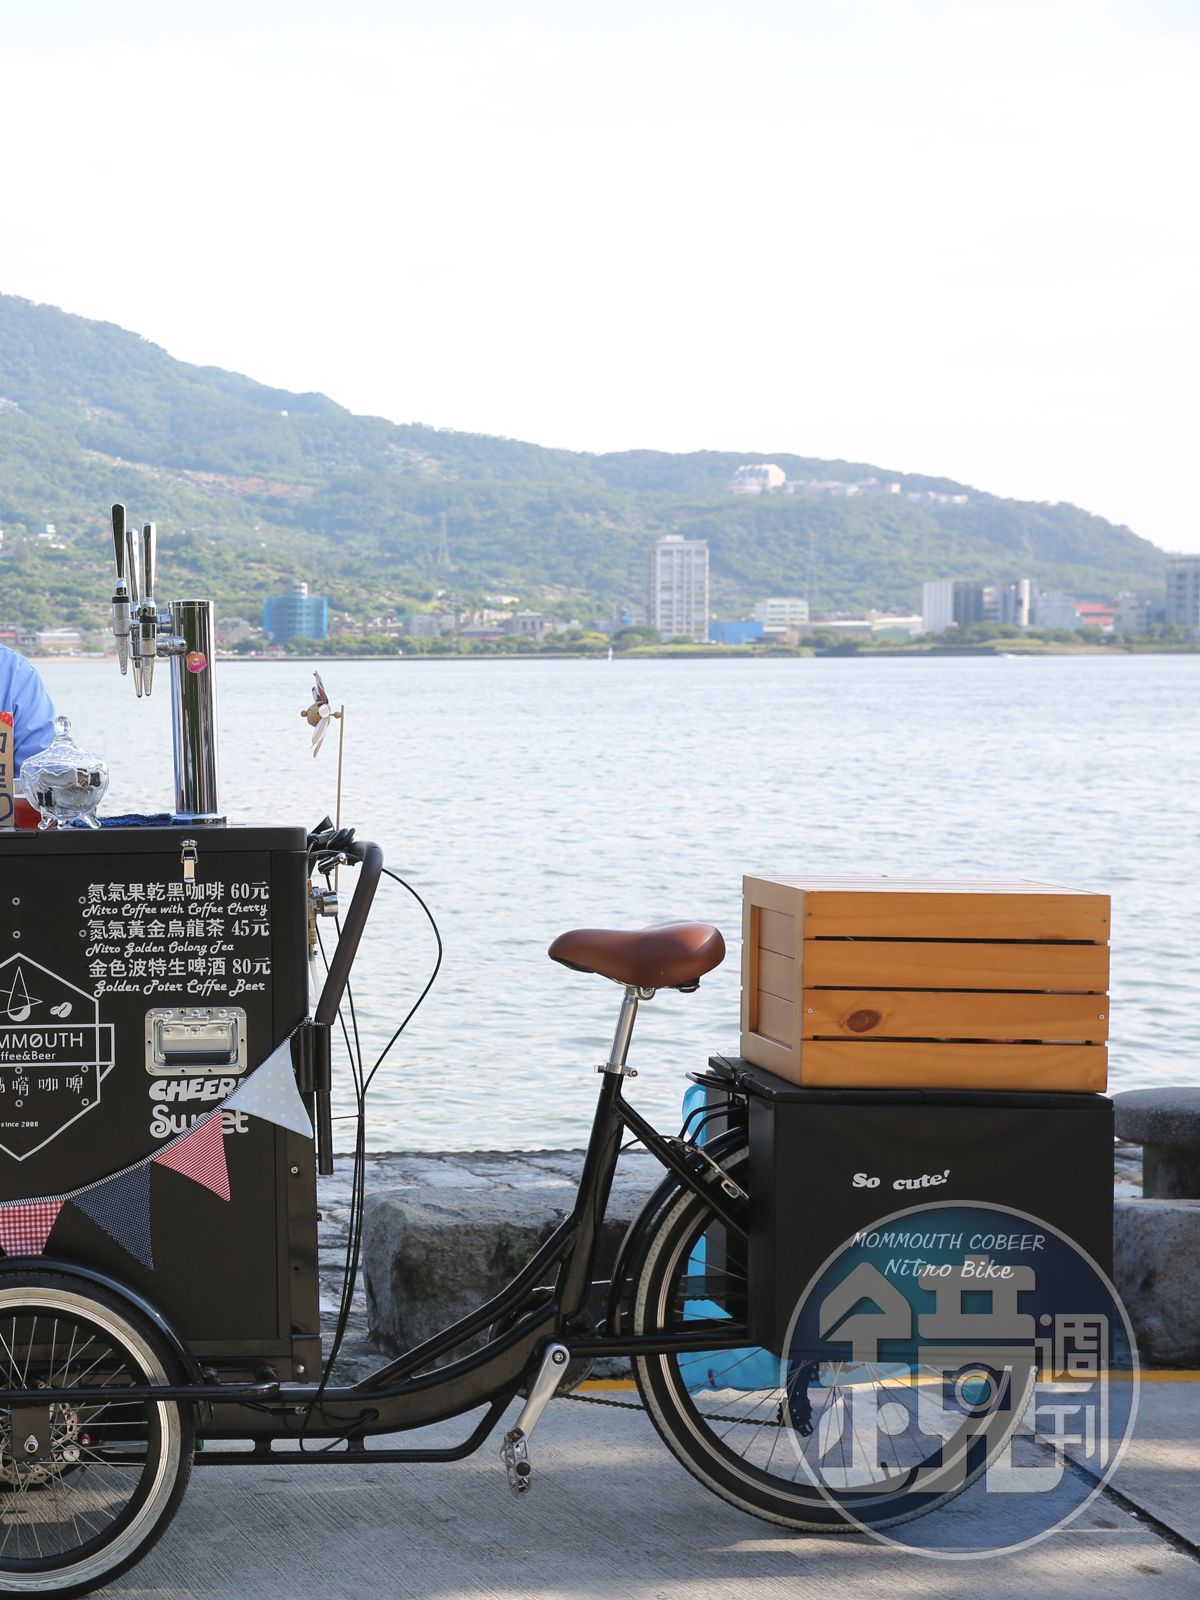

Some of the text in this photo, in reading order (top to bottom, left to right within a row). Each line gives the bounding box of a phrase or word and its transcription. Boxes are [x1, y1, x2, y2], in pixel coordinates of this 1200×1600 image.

[87, 881, 270, 904] 氮氣果乾黑咖啡 60元
[82, 902, 268, 919] Nitro Coffee with Coffee Cherry
[87, 918, 270, 942] 氮氣黃金烏龍茶 45元
[85, 940, 235, 958] Nitro Golden Oolong Tea
[88, 957, 272, 978] 金色波特生啤酒 80元
[93, 979, 266, 998] Golden Poter Coffee Beer
[852, 1169, 951, 1191] So cute!
[850, 1231, 1046, 1252] MOMMOUTH COBEER
[884, 1257, 1015, 1279] Nitro Bike
